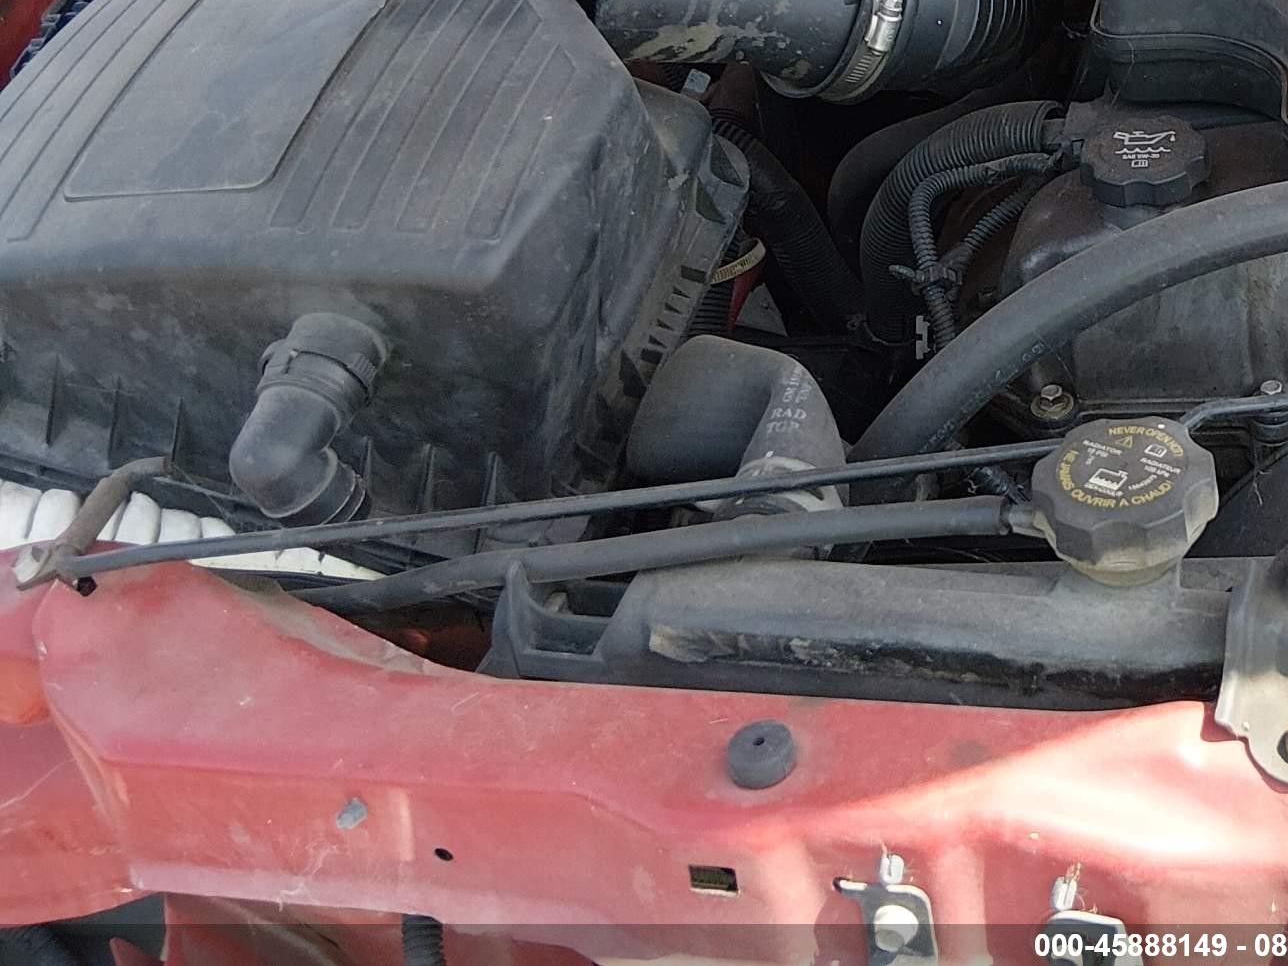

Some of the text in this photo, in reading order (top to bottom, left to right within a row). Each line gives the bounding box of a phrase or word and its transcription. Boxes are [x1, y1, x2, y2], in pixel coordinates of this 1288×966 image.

[770, 407, 808, 420] RAD
[1108, 425, 1146, 436] NEVER
[1145, 427, 1173, 444] OPEN
[1071, 489, 1117, 508] OUVRIR
